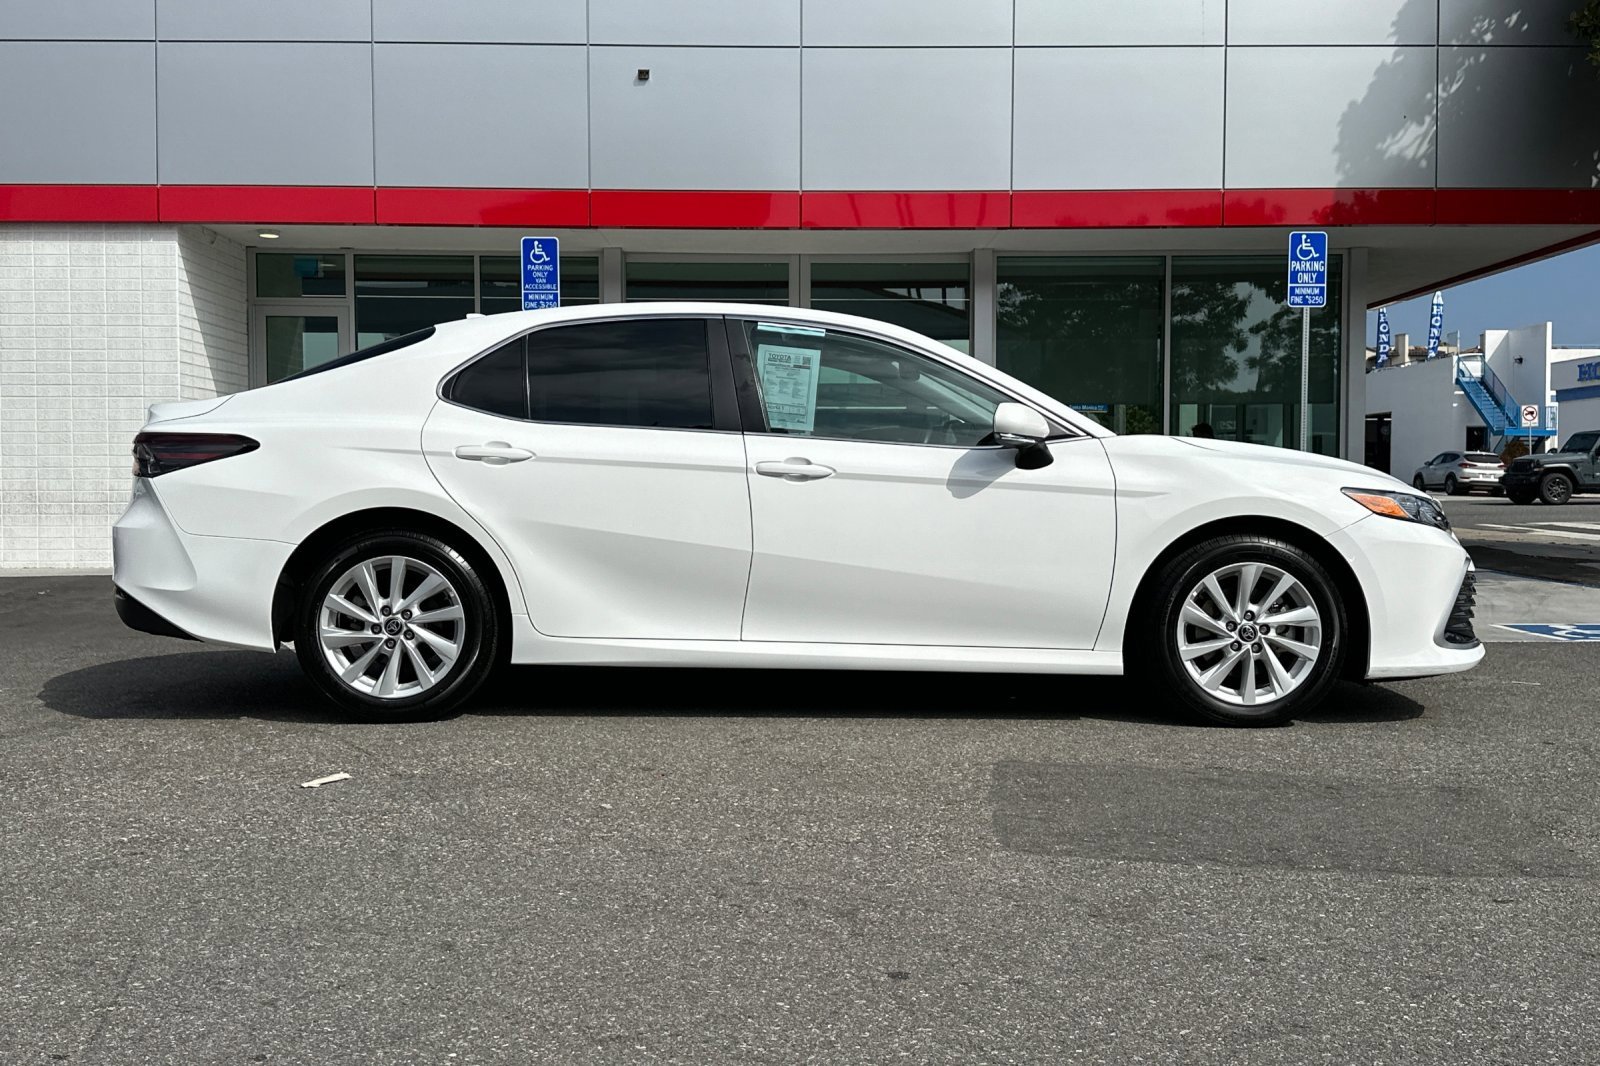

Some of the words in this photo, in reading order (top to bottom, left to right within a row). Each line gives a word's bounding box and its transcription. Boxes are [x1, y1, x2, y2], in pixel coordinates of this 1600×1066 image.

[1291, 261, 1324, 272] PARKING
[1297, 273, 1317, 283] ONLY
[1294, 287, 1319, 295] MINIMUM
[1290, 296, 1303, 304] FINE
[1307, 296, 1323, 304] $250
[768, 353, 791, 361] TOYOTA
